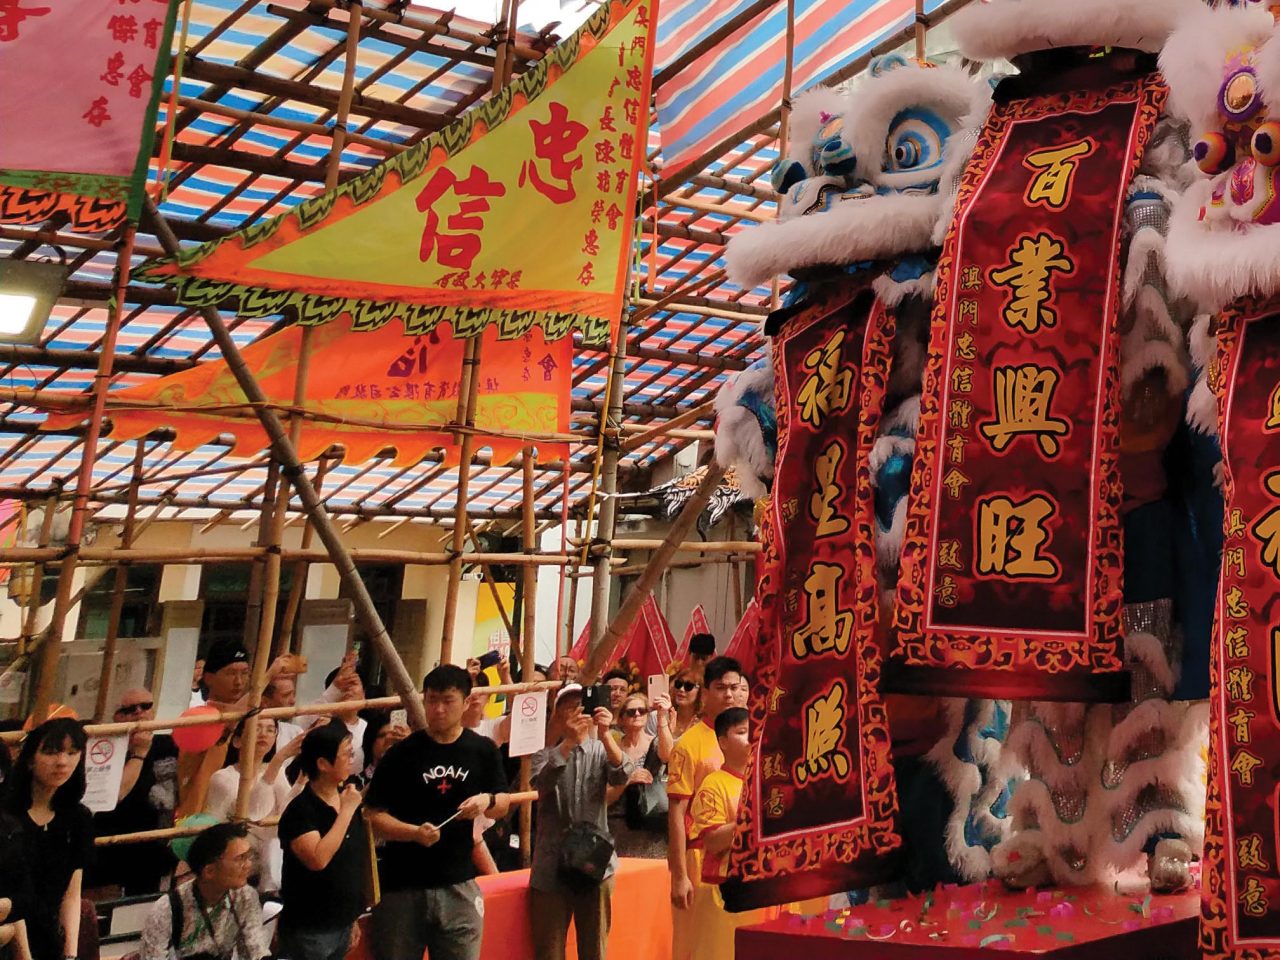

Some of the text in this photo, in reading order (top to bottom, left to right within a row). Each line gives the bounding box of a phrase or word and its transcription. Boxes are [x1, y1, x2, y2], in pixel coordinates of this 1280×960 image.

[793, 329, 855, 781] 福星高照
[978, 140, 1092, 579] 百業興旺
[422, 765, 469, 784] NOAH
